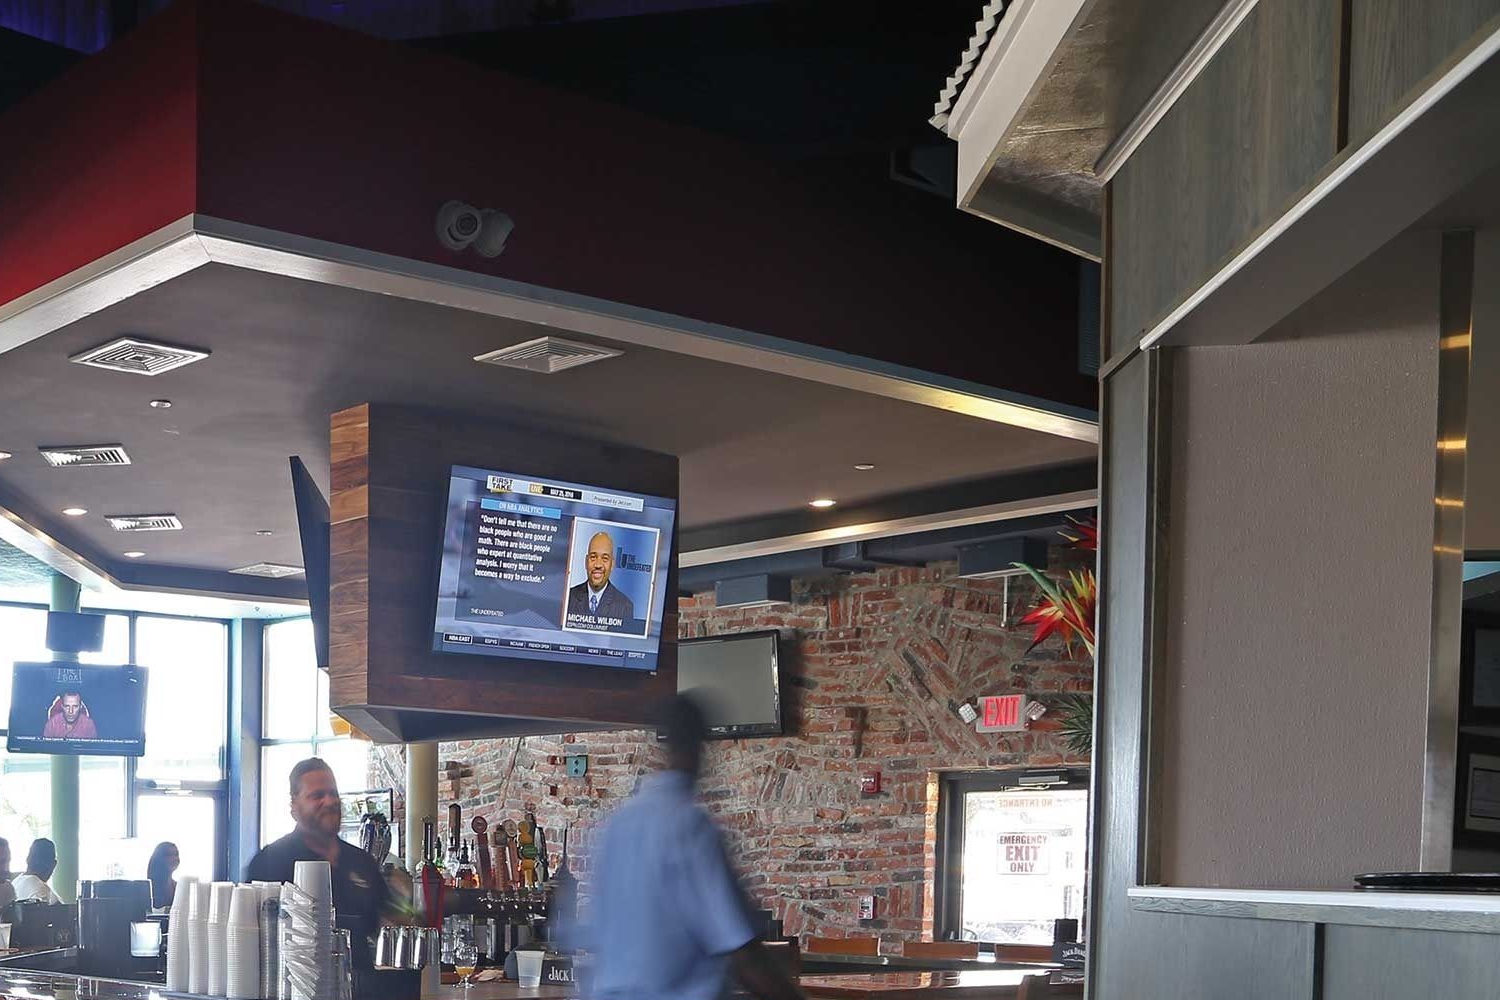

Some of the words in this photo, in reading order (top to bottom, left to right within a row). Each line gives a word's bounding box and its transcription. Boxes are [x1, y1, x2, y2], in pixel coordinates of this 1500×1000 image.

[492, 477, 513, 485] FIRST
[518, 504, 544, 514] ANALYTICS
[498, 517, 506, 525] tell
[516, 520, 527, 528] that
[528, 522, 540, 530] there
[480, 526, 494, 534] black
[494, 528, 512, 538] people
[512, 530, 524, 538] who
[534, 533, 546, 542] good
[478, 537, 494, 546] math.
[494, 538, 508, 547] There
[519, 542, 532, 550] black
[534, 544, 550, 553] people
[490, 549, 506, 558] expert
[512, 552, 542, 562] quantitative
[476, 558, 498, 568] analysis.
[502, 562, 518, 571] worry
[518, 563, 529, 571] that
[474, 568, 498, 578] becomes
[503, 572, 514, 581] way
[568, 614, 596, 624] MICHAEL
[598, 616, 622, 626] WILBON
[984, 696, 1021, 728] EXIT
[1000, 835, 1048, 845] EMERGENCY
[1006, 846, 1040, 862] EXIT
[1010, 863, 1034, 872] ONLY
[548, 966, 570, 982] JACK
